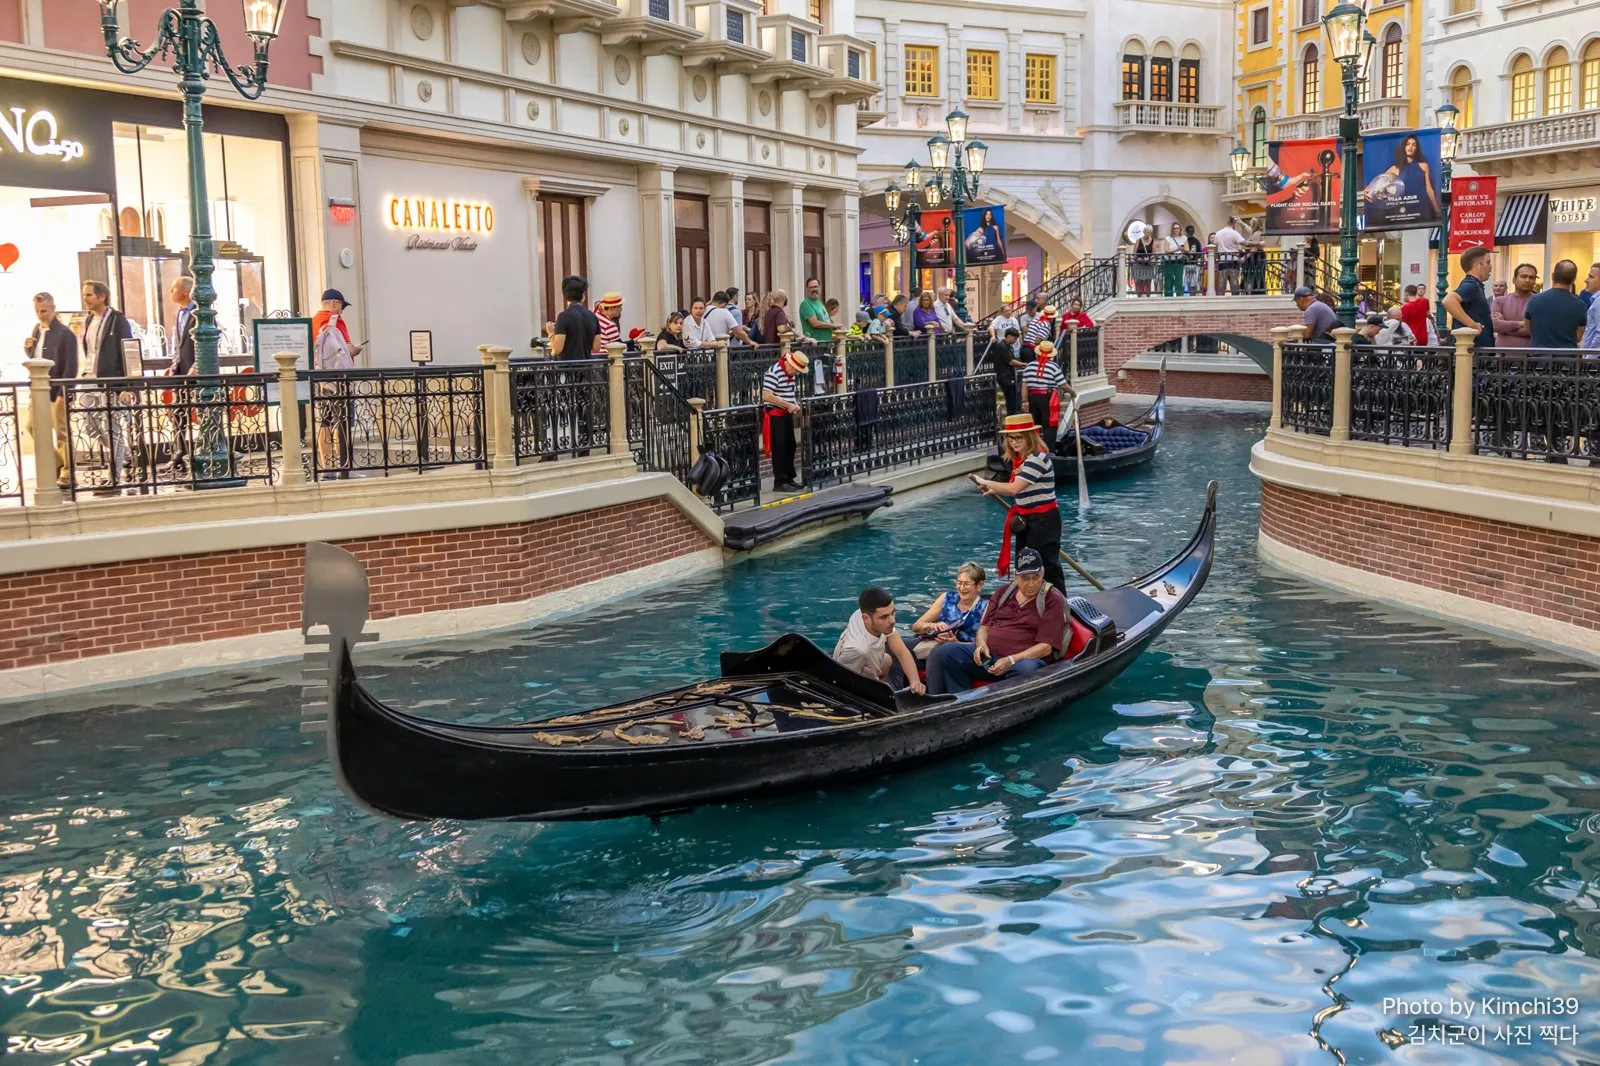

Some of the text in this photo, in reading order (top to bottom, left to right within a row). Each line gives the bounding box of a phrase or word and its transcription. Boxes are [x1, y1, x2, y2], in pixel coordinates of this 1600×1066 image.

[1549, 198, 1595, 213] WHITE
[390, 198, 494, 232] CANALETTO
[1554, 213, 1588, 223] HOUSE
[659, 361, 674, 370] EXIT
